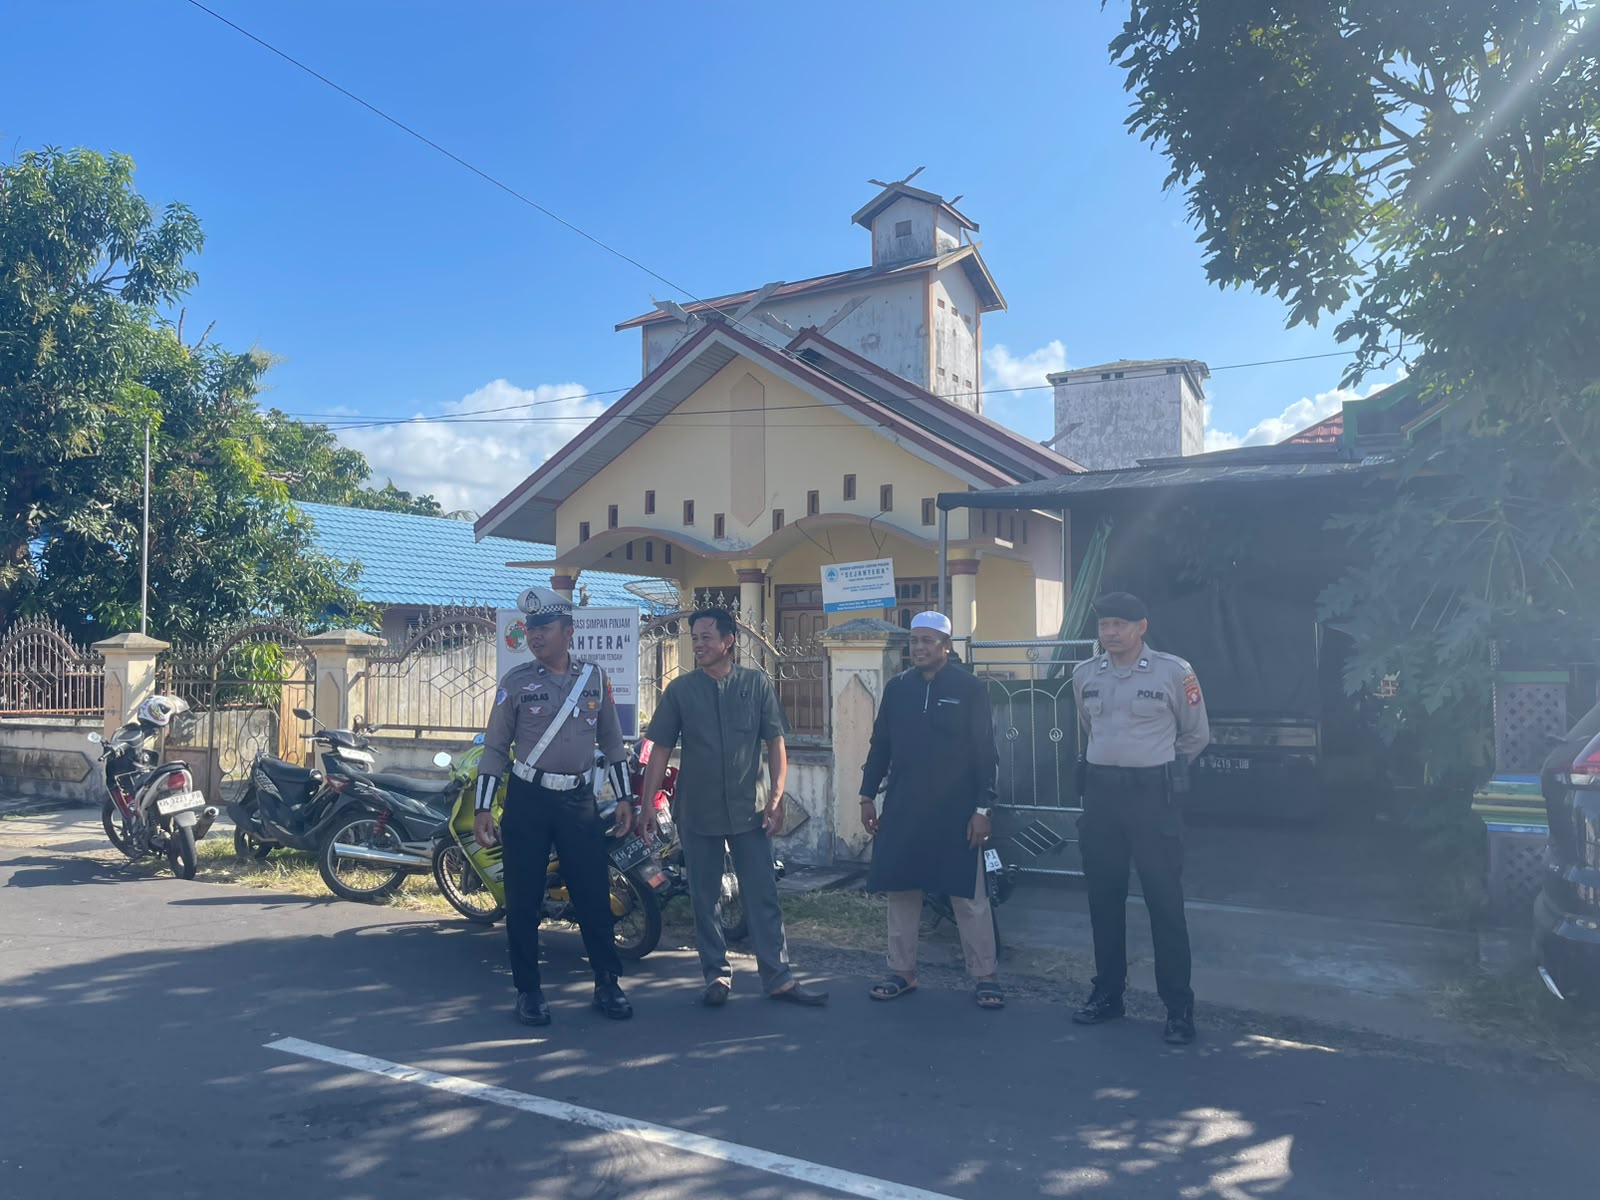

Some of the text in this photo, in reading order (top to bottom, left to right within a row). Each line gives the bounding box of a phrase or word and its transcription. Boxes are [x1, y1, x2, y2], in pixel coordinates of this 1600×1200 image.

[573, 618, 630, 629] RASI SIMPAN PINJAM
[568, 634, 630, 650] AHTERA“
[1137, 689, 1164, 699] POLRI
[614, 850, 627, 861] KH
